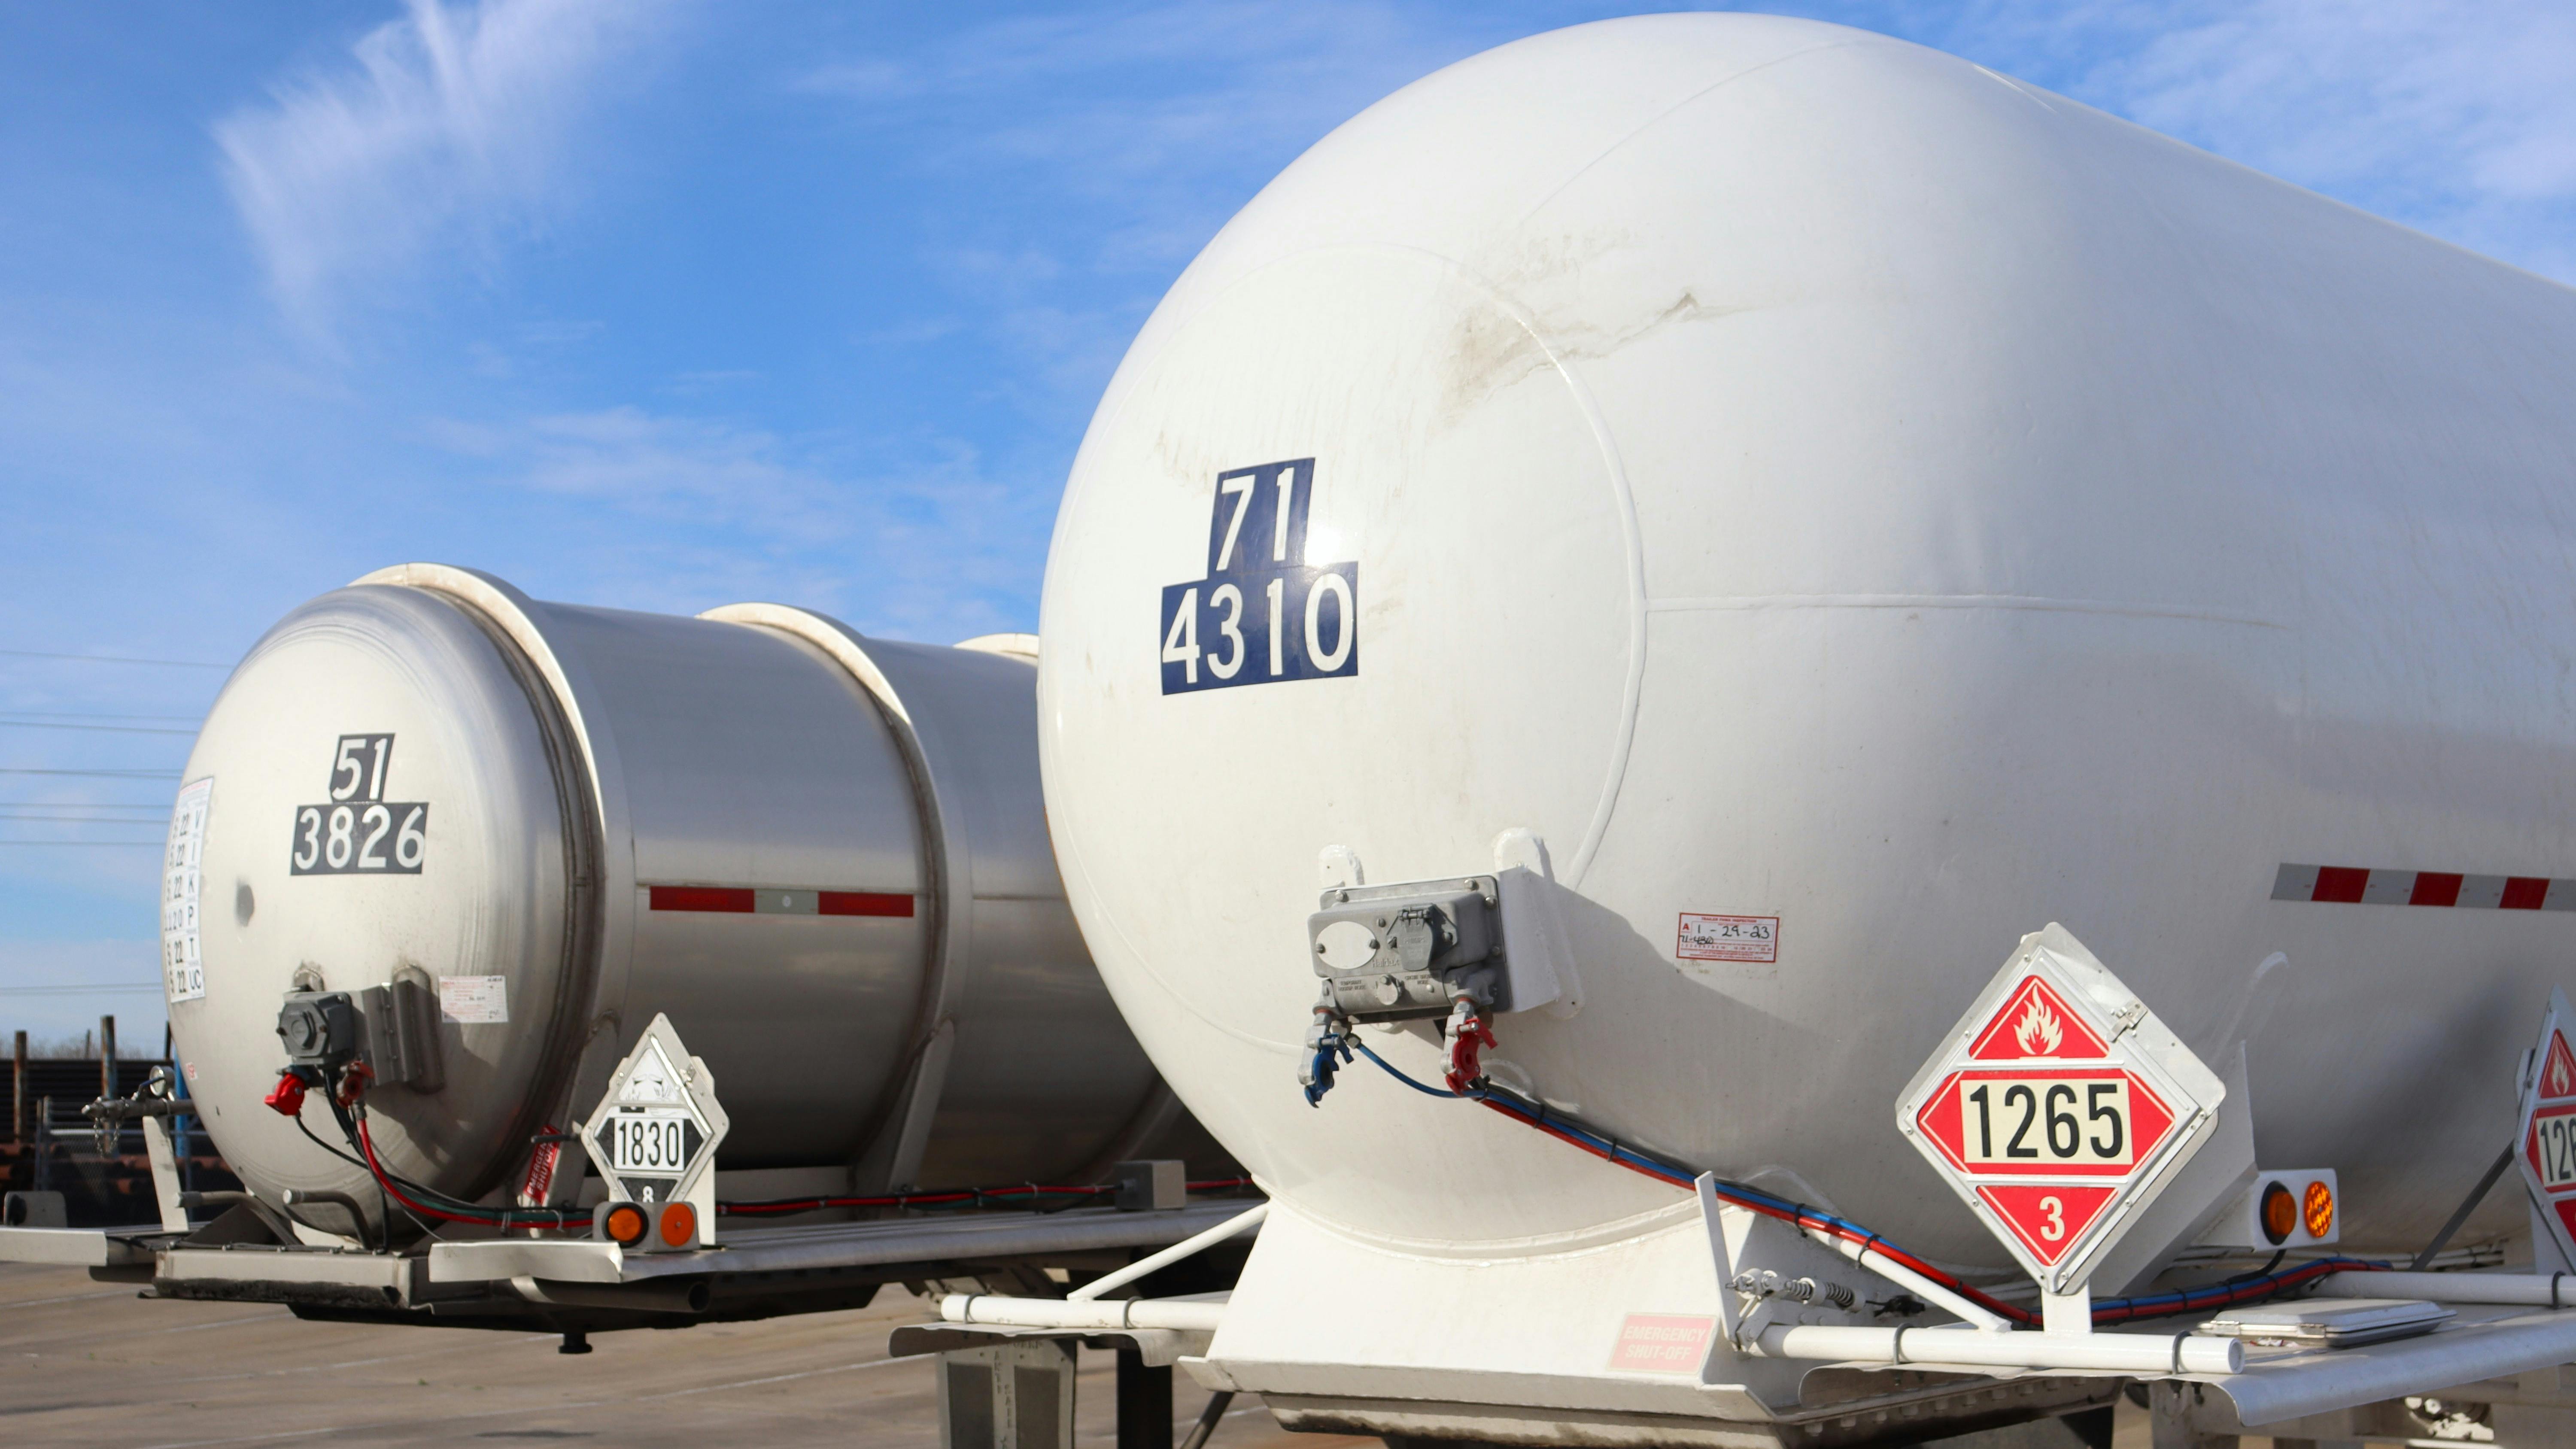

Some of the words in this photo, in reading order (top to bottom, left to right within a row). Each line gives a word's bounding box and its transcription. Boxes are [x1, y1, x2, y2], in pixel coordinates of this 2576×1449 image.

[1216, 467, 1294, 571] 71
[1162, 573, 1354, 683] 4310
[331, 738, 388, 801] 51
[295, 805, 425, 870] 3826
[188, 872, 194, 893] K
[188, 905, 194, 926] P
[1683, 923, 1689, 931] A
[189, 937, 194, 957] T
[189, 969, 201, 990] UC
[1970, 1084, 2122, 1158] 1265
[619, 1121, 679, 1166] 1830
[527, 1127, 551, 1195] EMERGENY
[642, 1185, 655, 1203] 8
[2039, 1196, 2065, 1241] 3
[1624, 1326, 1707, 1343] EMERGENCY
[1625, 1344, 1692, 1360] SHUT-OFF
